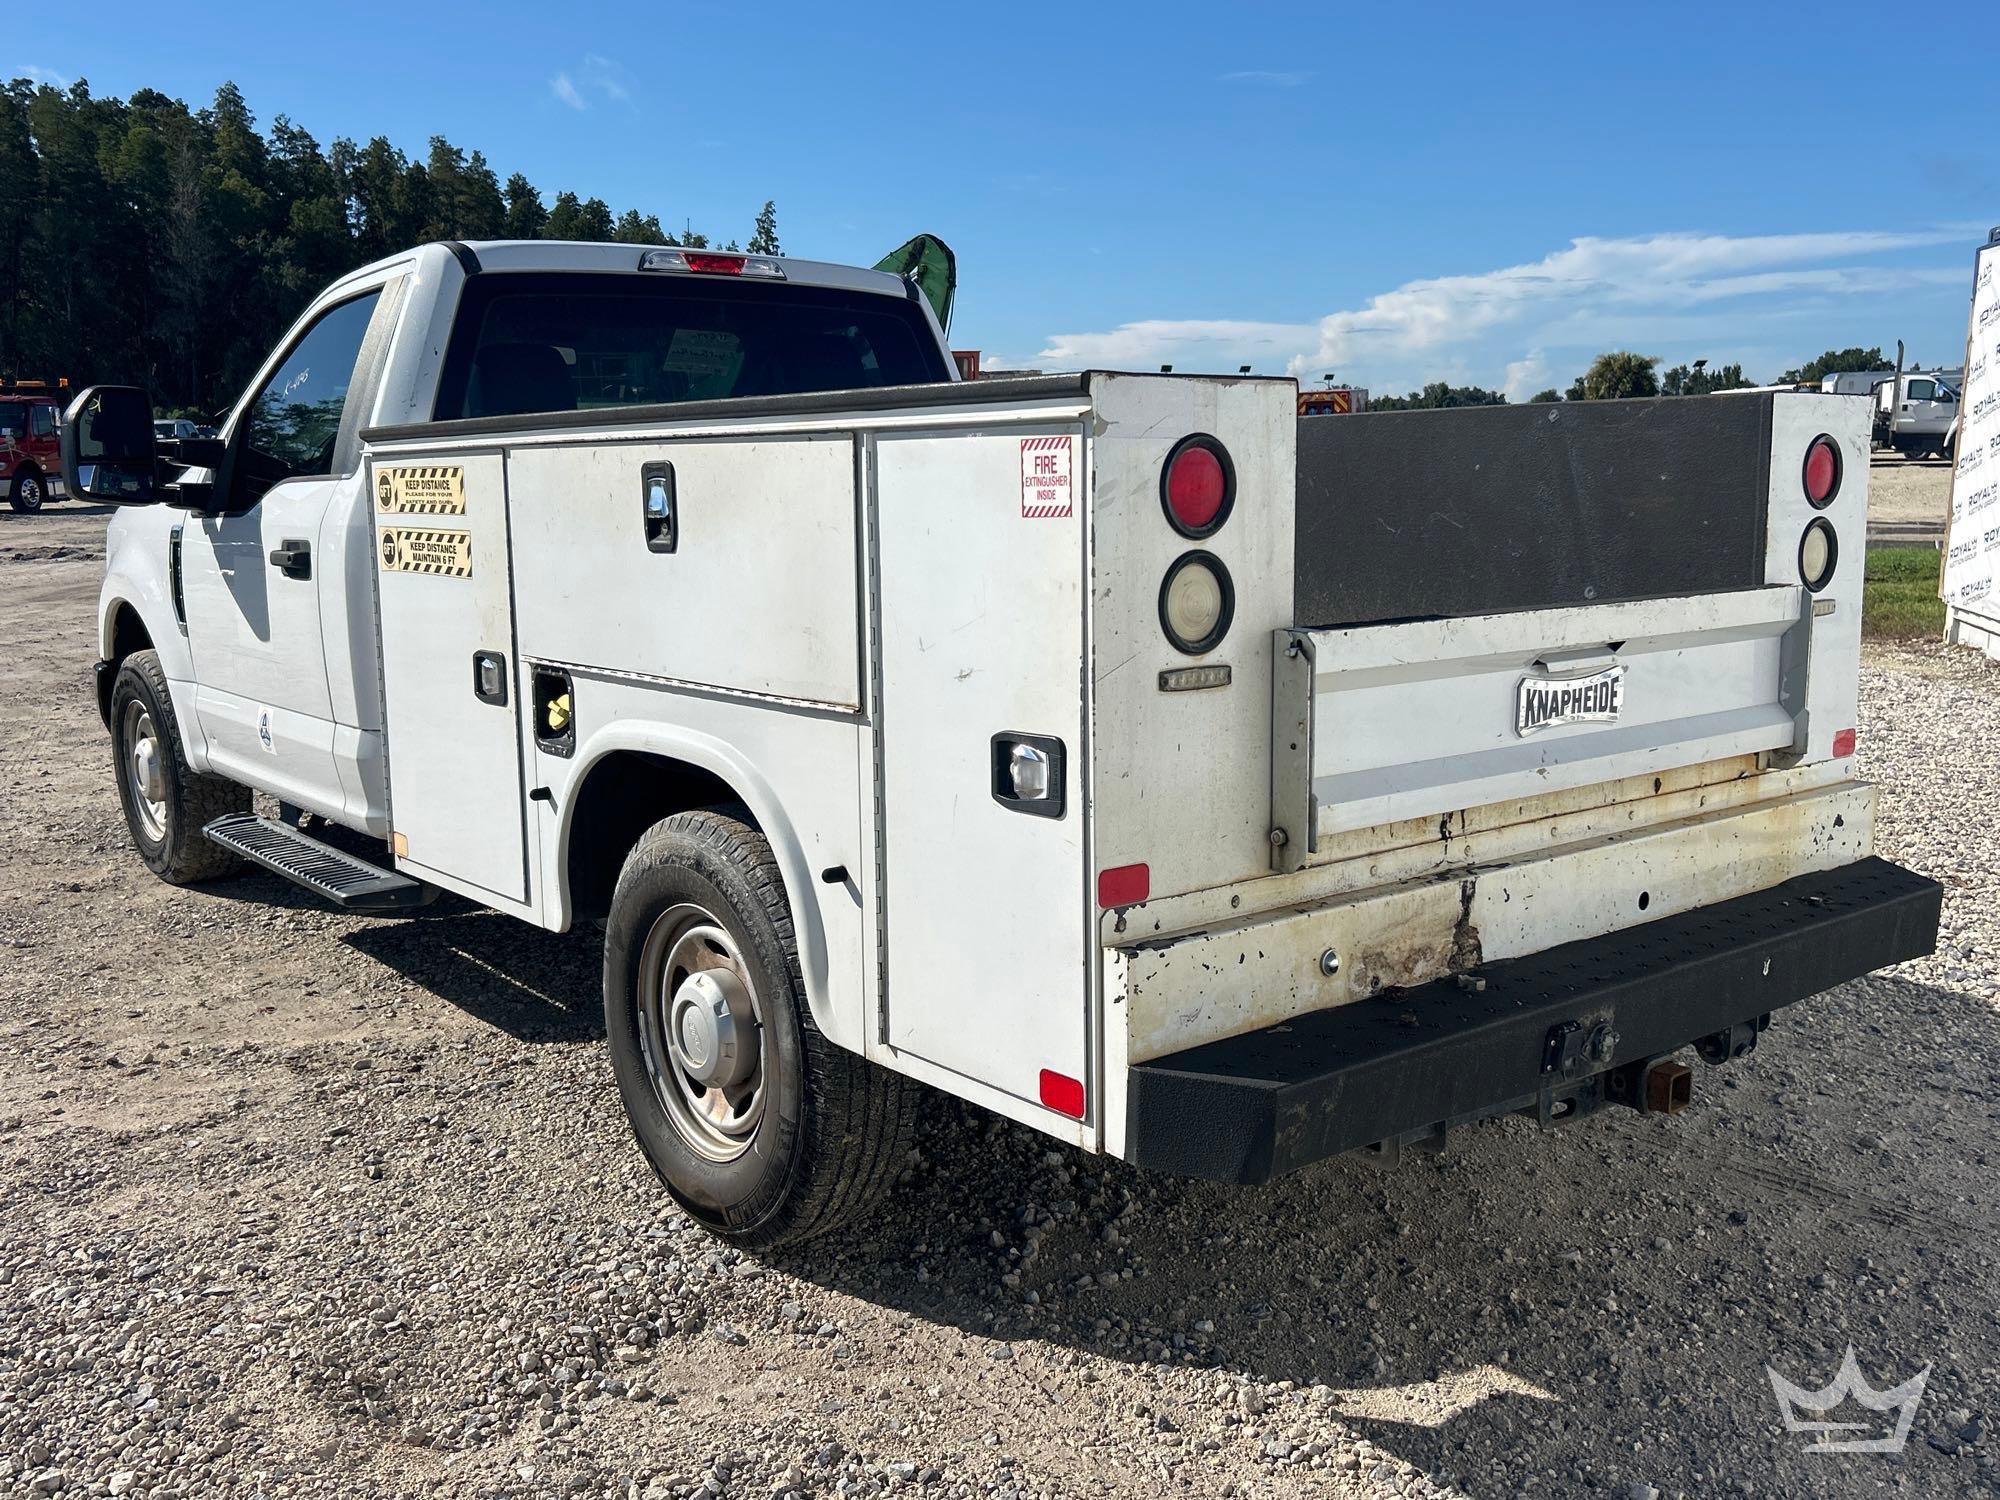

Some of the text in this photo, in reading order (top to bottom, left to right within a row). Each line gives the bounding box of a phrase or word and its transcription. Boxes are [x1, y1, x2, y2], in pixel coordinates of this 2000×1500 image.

[1034, 455, 1058, 474] FIRE
[405, 479, 450, 490] KEEP DISTANCE
[1025, 475, 1068, 487] EXTINGUISHER
[1037, 489, 1056, 501] INSIDE
[1969, 486, 1990, 507] ROYAL
[410, 542, 457, 555] KEEP DISTANCE
[1950, 542, 1971, 559] ROYAL
[412, 552, 456, 566] MAINTAIN 6 FT
[1961, 579, 1984, 598] ROYAL
[1524, 675, 1620, 727] KNAPHEIDE
